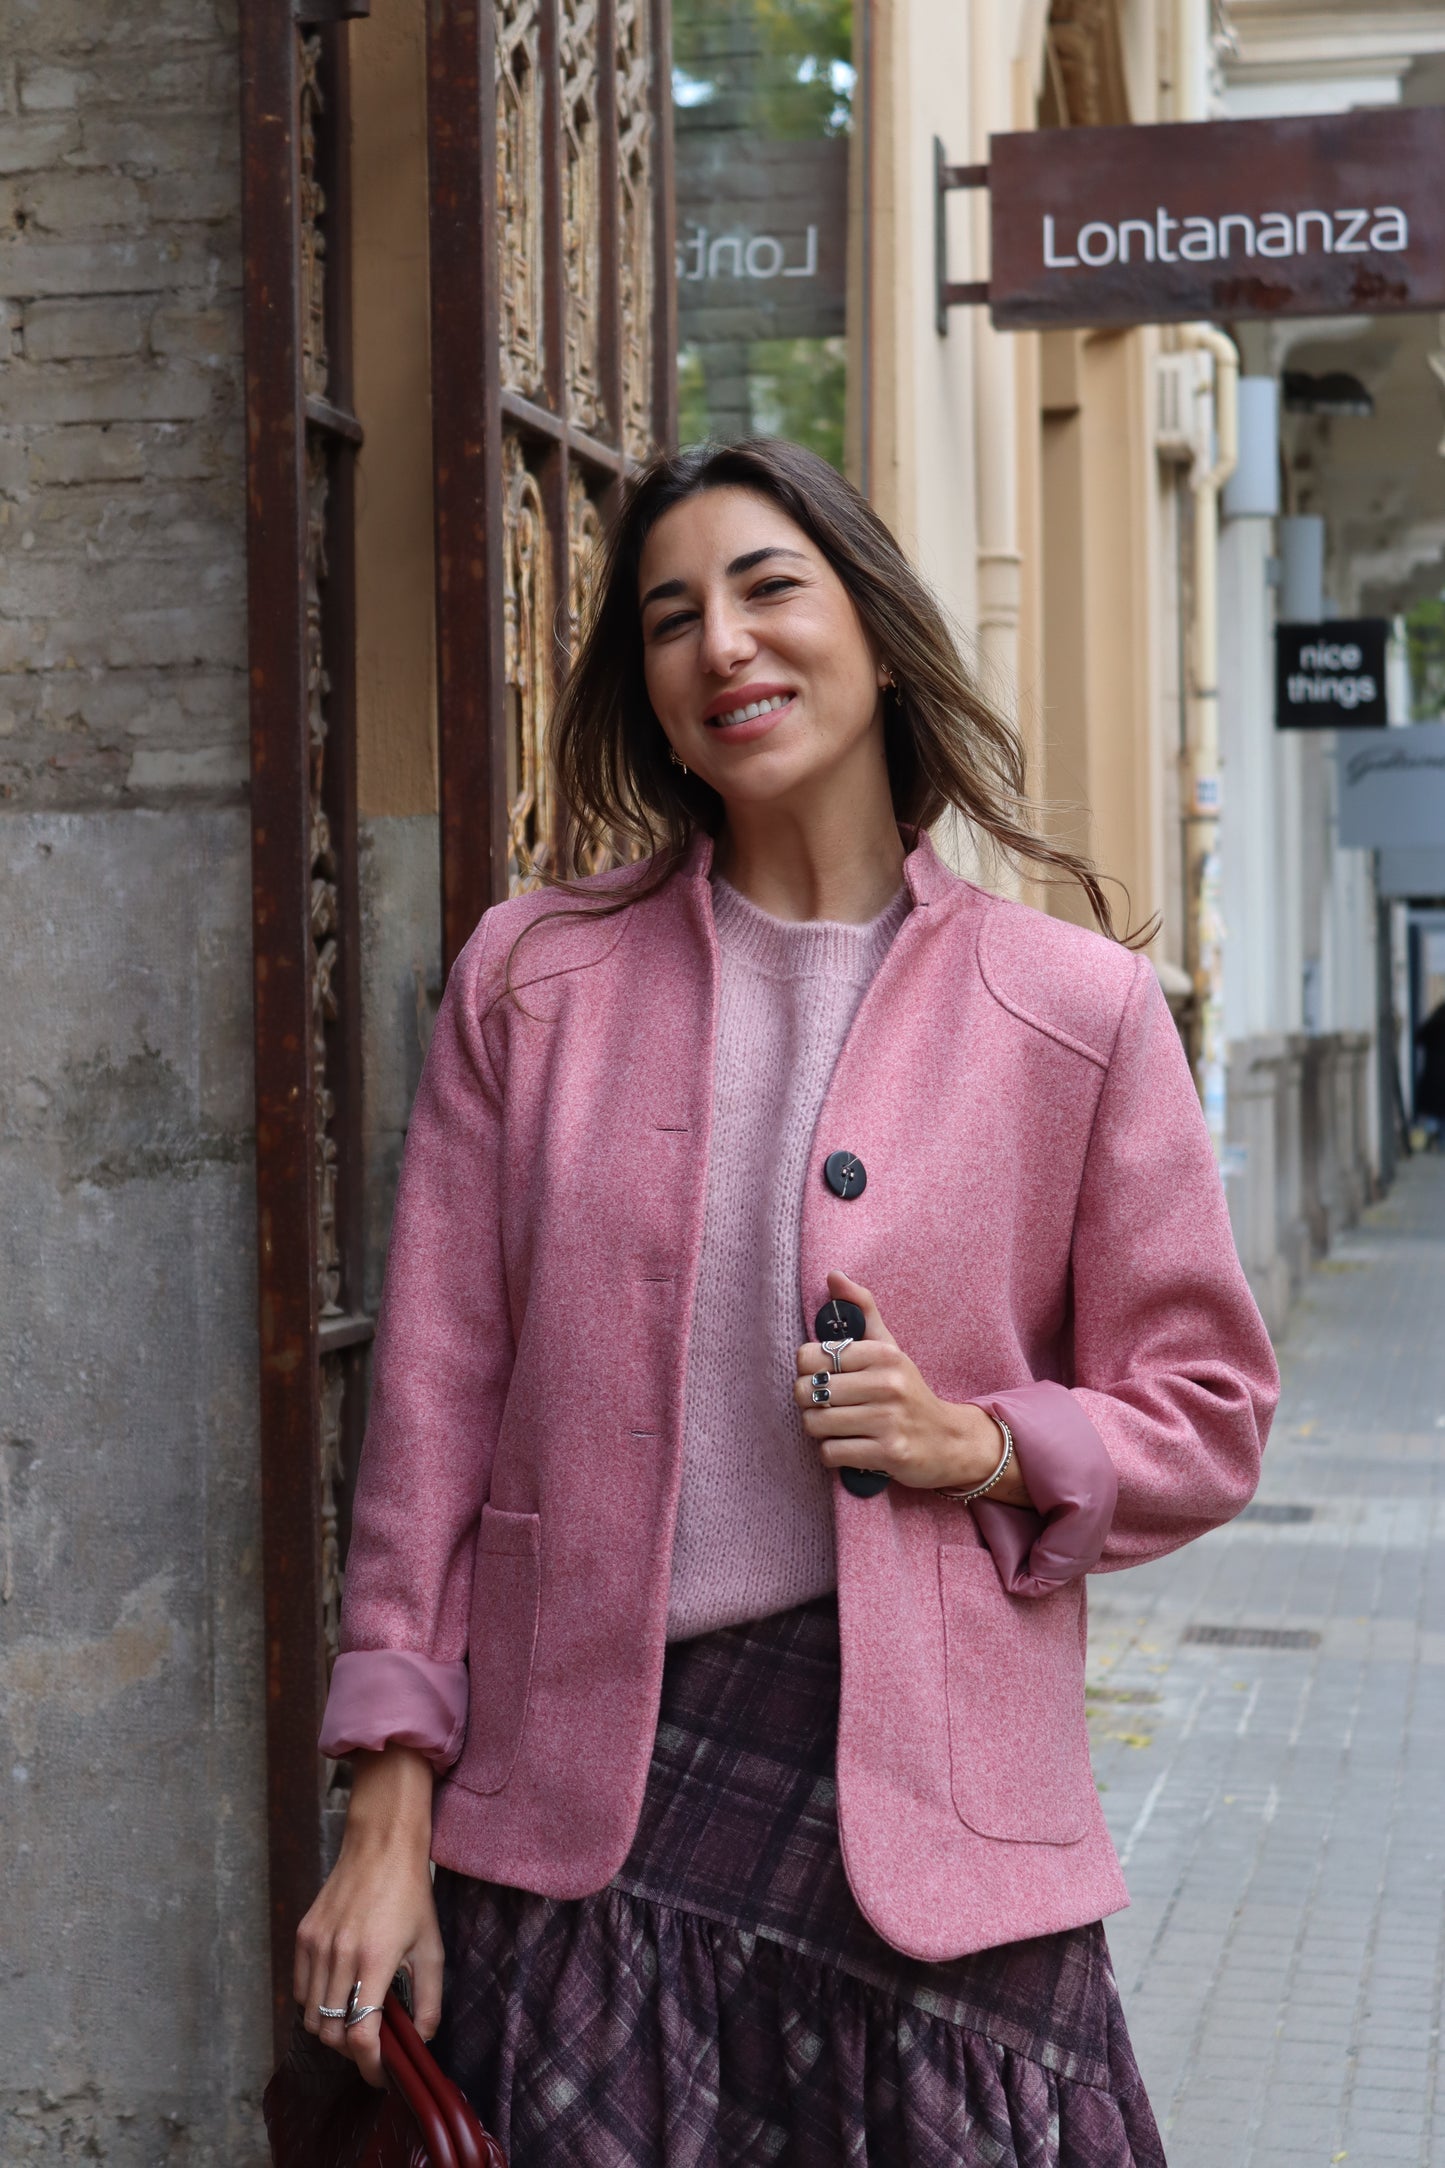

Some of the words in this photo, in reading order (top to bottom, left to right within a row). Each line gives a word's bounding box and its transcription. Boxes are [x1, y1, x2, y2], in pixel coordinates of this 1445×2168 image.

[1043, 206, 1408, 268] Lontananza
[1300, 641, 1362, 671] nice
[1287, 673, 1376, 709] things
